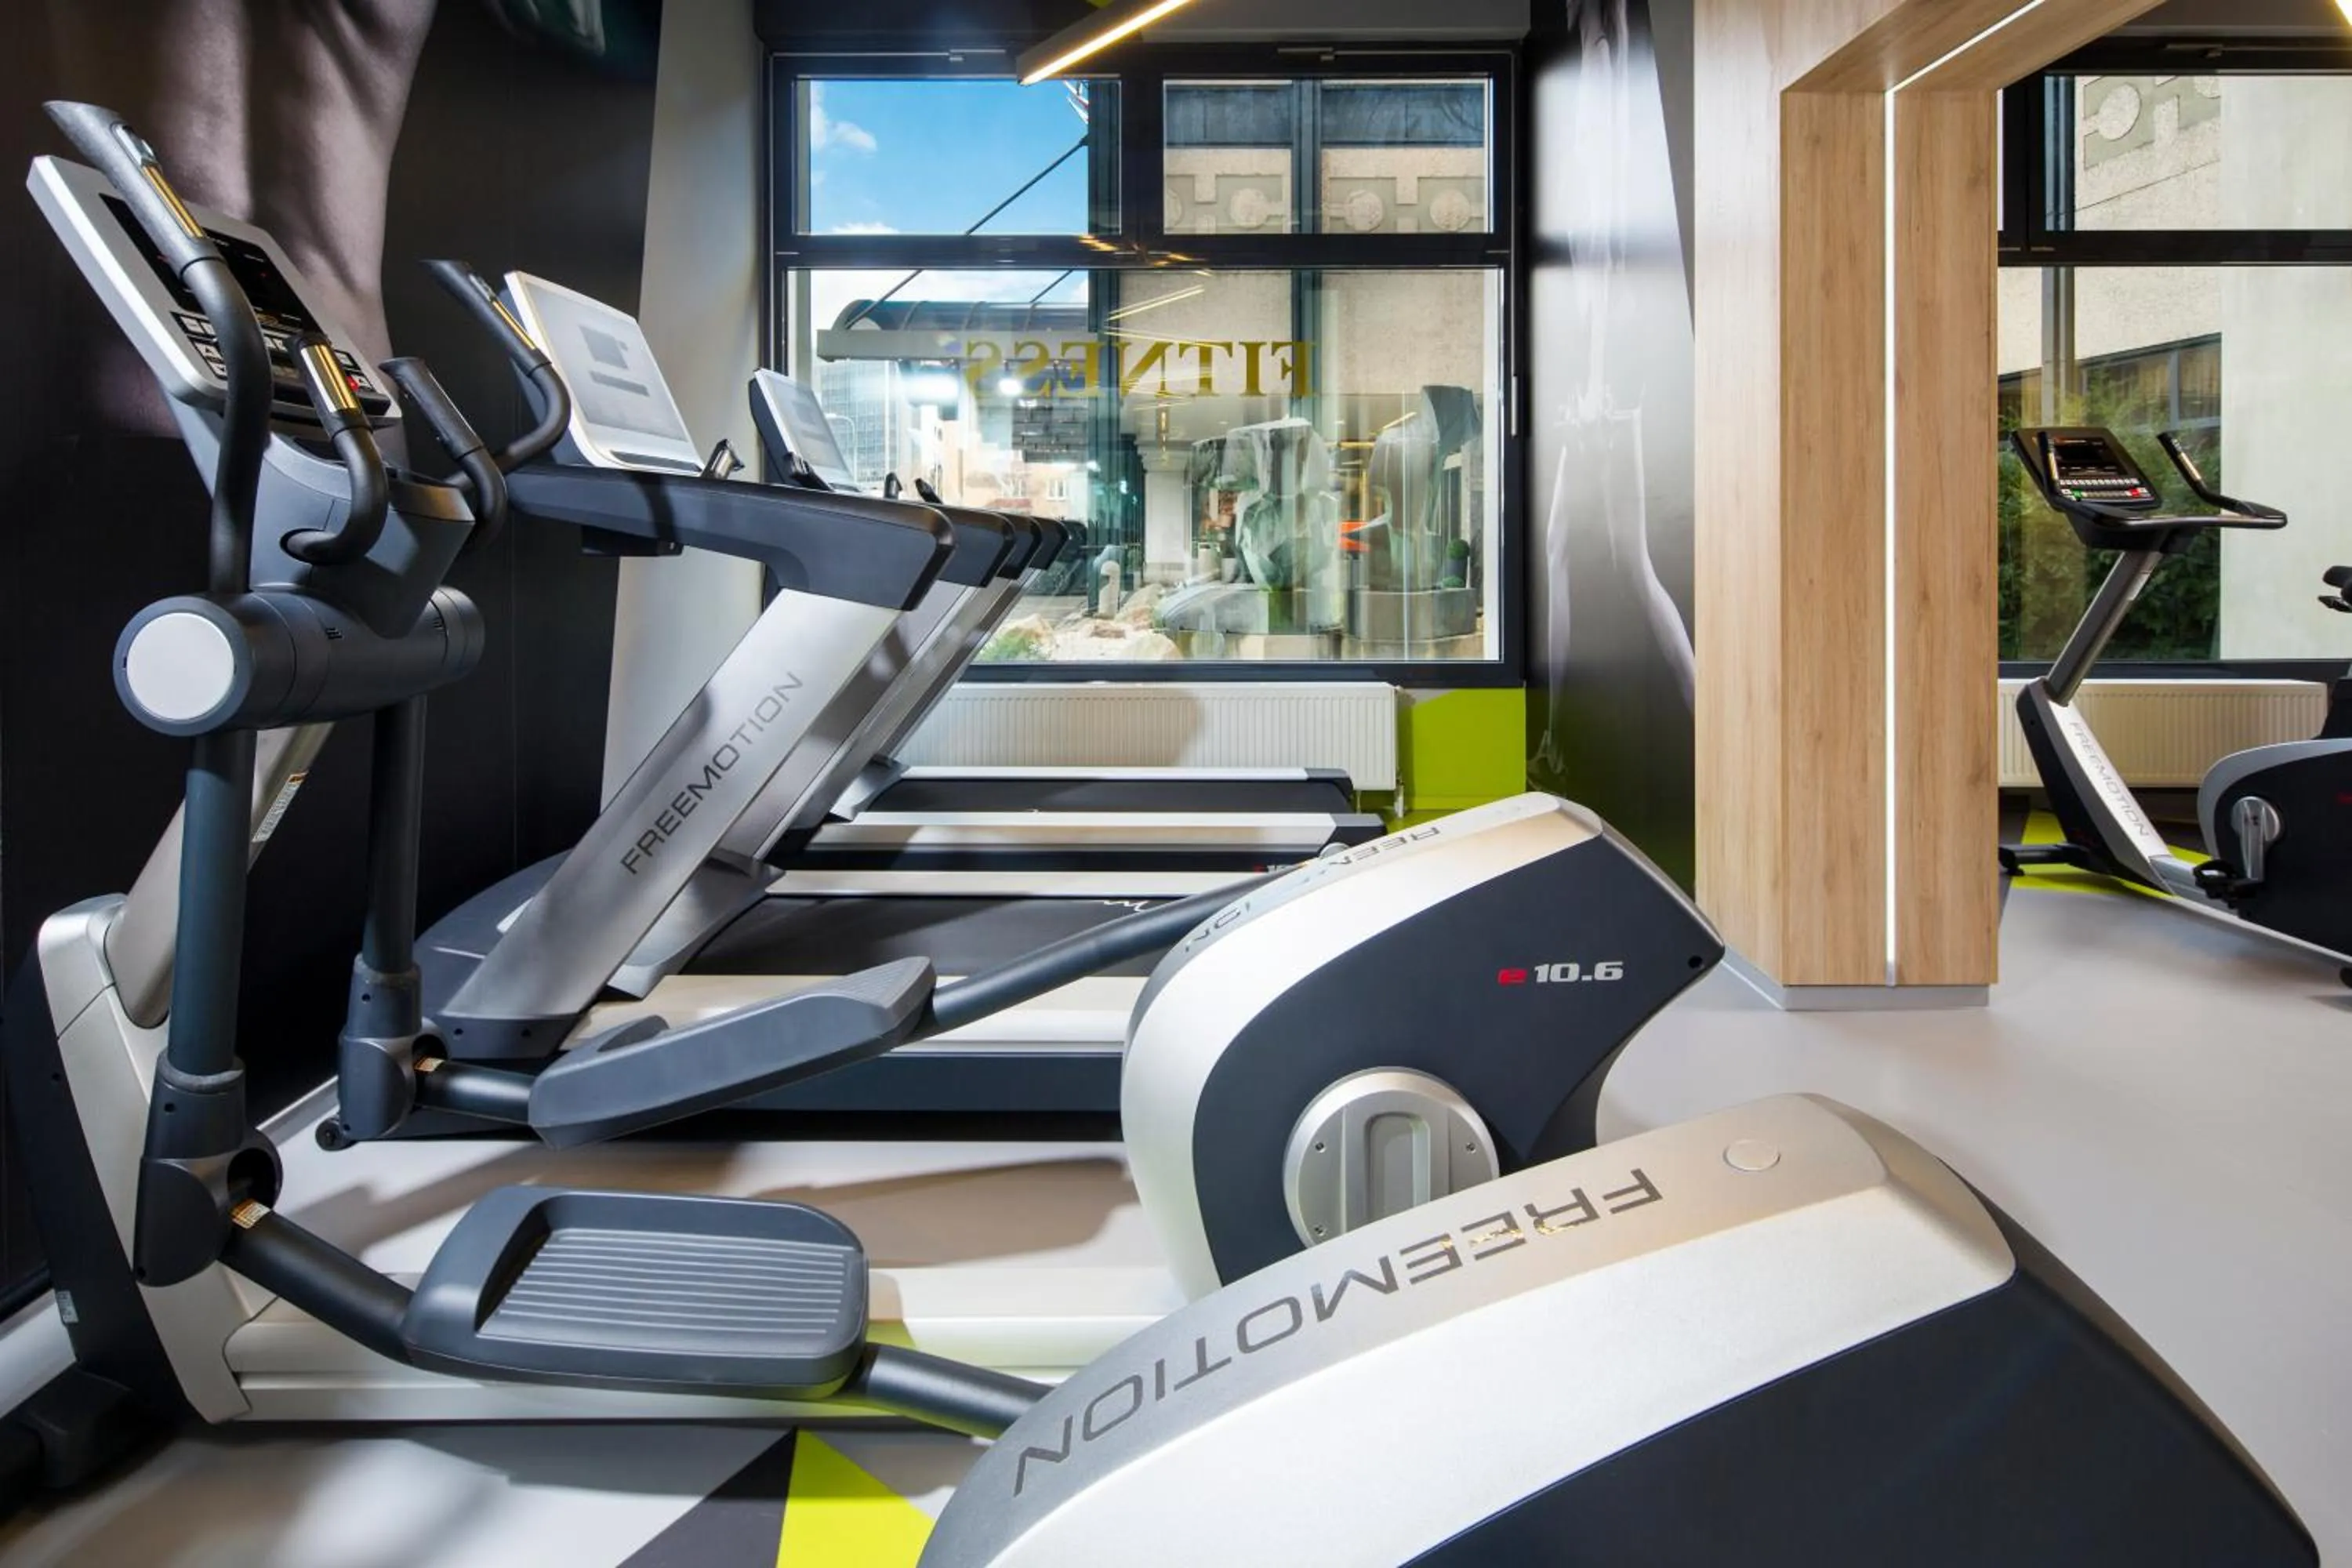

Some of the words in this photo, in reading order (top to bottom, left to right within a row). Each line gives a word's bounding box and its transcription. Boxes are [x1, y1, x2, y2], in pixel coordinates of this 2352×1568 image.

[619, 671, 804, 875] FREEMOTION
[2069, 721, 2149, 837] FREEMOTION
[1013, 1167, 1664, 1497] FREEMOTION
